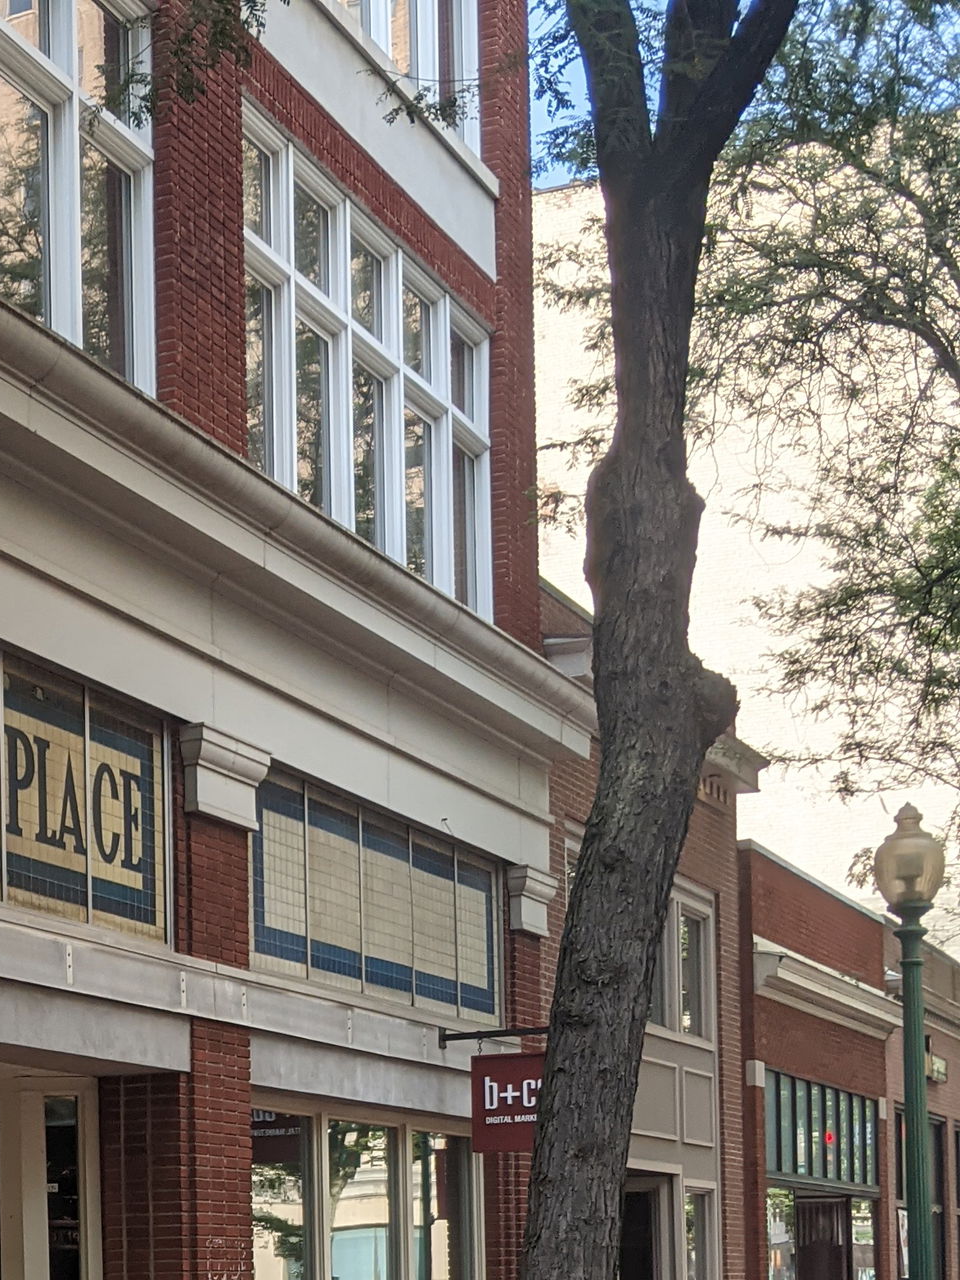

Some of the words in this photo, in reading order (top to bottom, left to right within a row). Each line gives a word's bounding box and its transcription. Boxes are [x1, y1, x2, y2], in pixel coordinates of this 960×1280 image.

[5, 726, 143, 872] PLACE
[484, 1076, 542, 1110] b+c
[486, 1115, 513, 1125] DIGITAL
